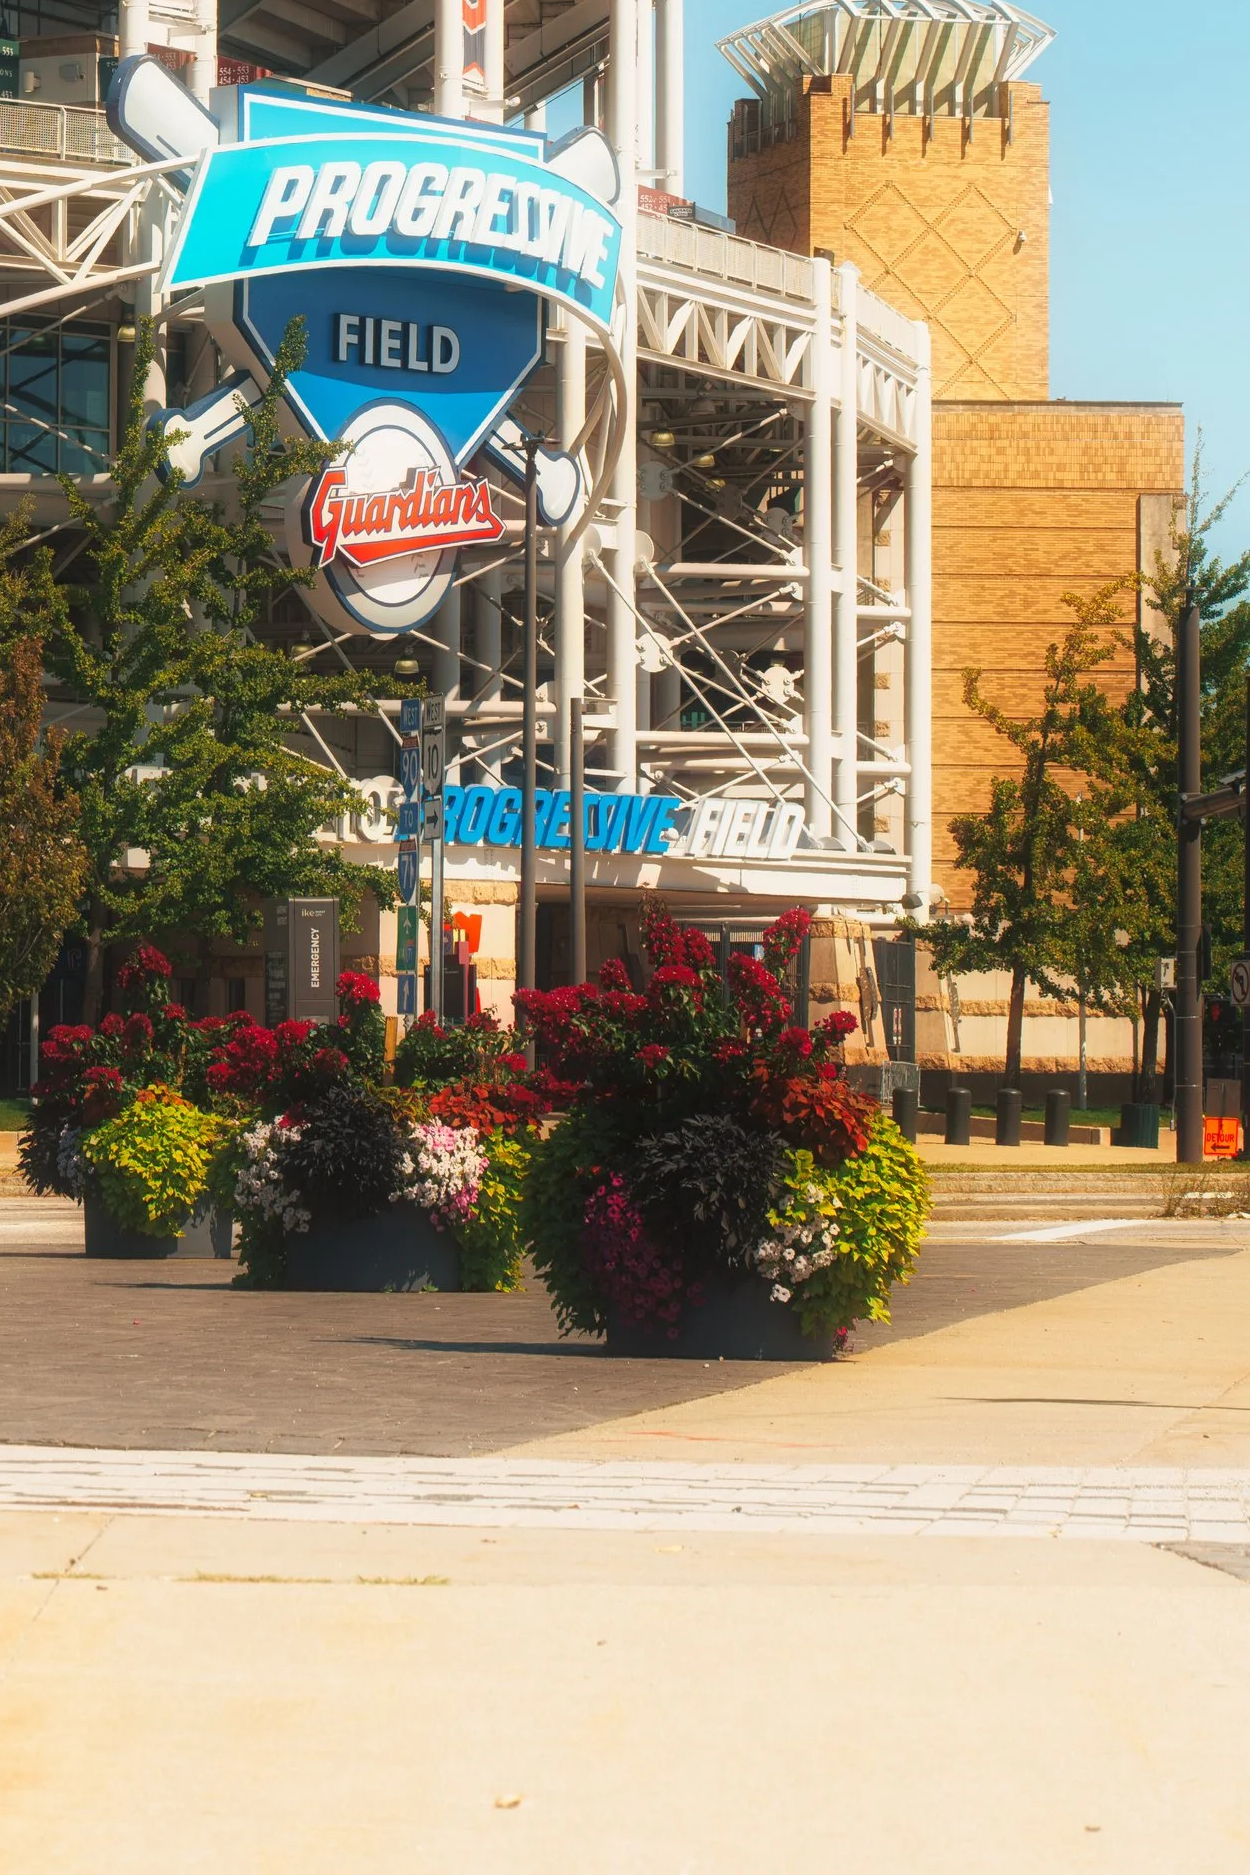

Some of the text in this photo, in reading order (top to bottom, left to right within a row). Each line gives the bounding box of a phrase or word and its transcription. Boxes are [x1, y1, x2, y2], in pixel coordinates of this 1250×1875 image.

[219, 66, 249, 76] 554 553
[219, 75, 249, 85] 454 453
[246, 160, 615, 291] PROGRESSIVE
[337, 312, 461, 373] FIELD
[310, 466, 507, 568] Guardians
[403, 706, 418, 725] WEST
[427, 702, 441, 723] WEST
[402, 750, 418, 786] 90
[427, 743, 439, 780] 10
[395, 784, 681, 853] ROGRESSIVE
[686, 797, 806, 860] FIELD
[404, 809, 413, 828] TO
[401, 854, 413, 889] 71
[301, 908, 315, 917] ike
[310, 927, 320, 988] EMERGENCY
[1206, 1132, 1235, 1143] DETOUR
